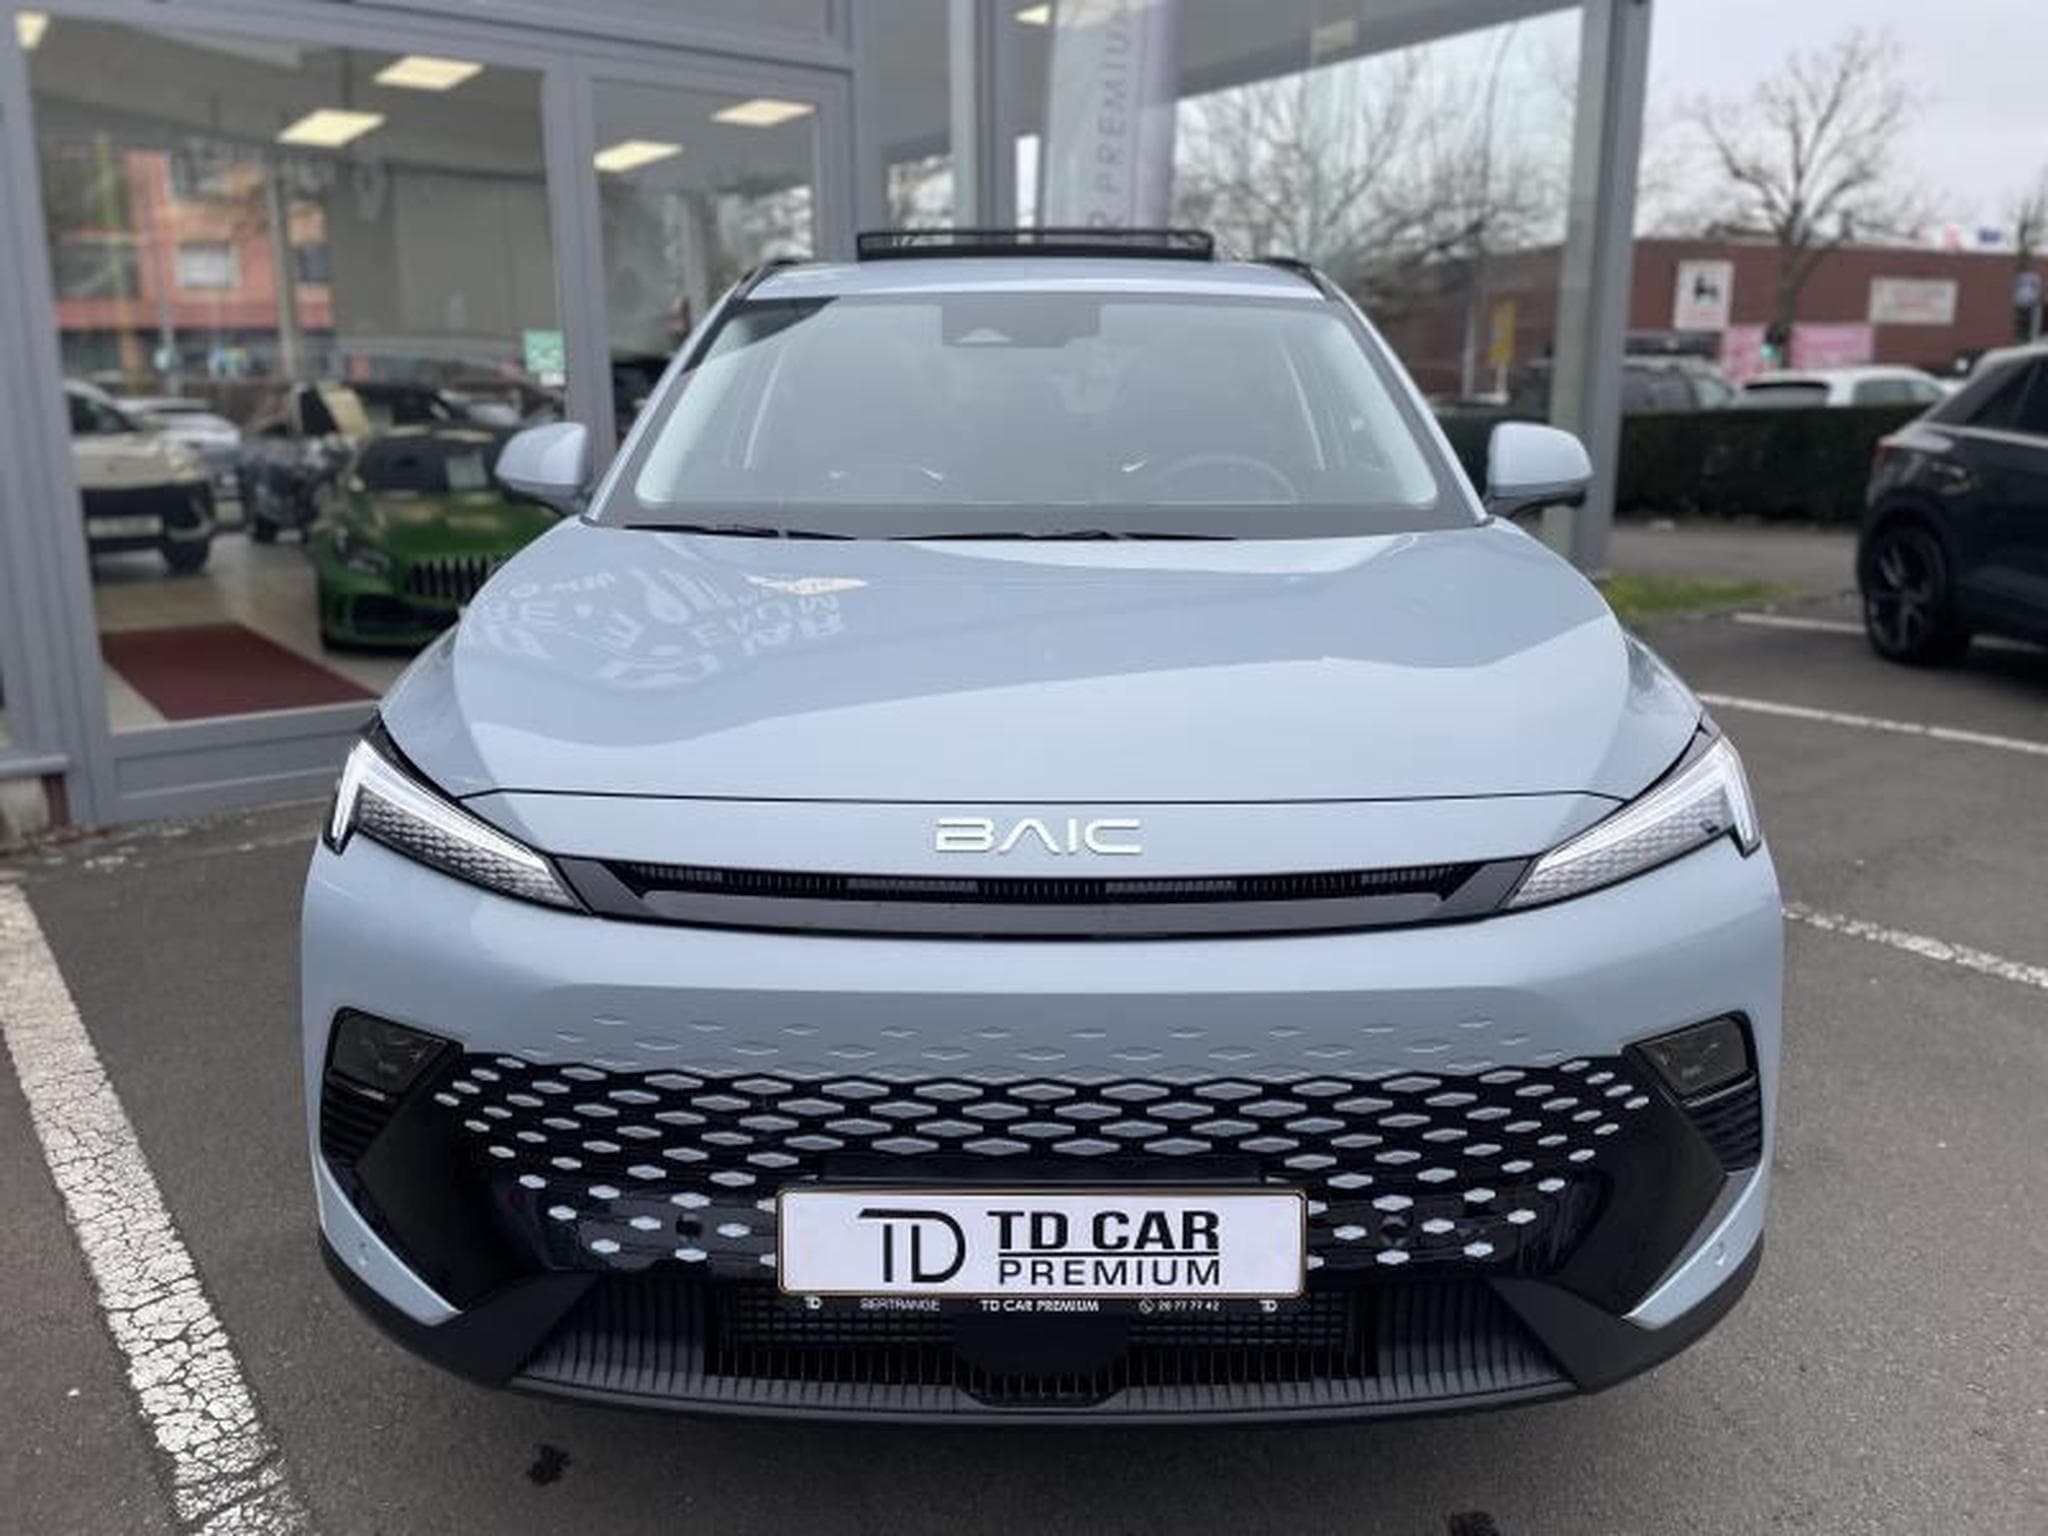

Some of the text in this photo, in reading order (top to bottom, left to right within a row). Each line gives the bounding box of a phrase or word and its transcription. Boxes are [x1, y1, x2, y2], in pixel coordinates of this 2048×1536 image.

[935, 817, 1142, 855] BAIC
[858, 1208, 966, 1283] TD
[987, 1211, 1219, 1250] TD CAR
[999, 1259, 1220, 1286] PREMIUM
[980, 1299, 1099, 1312] TD CAR PREMIUM
